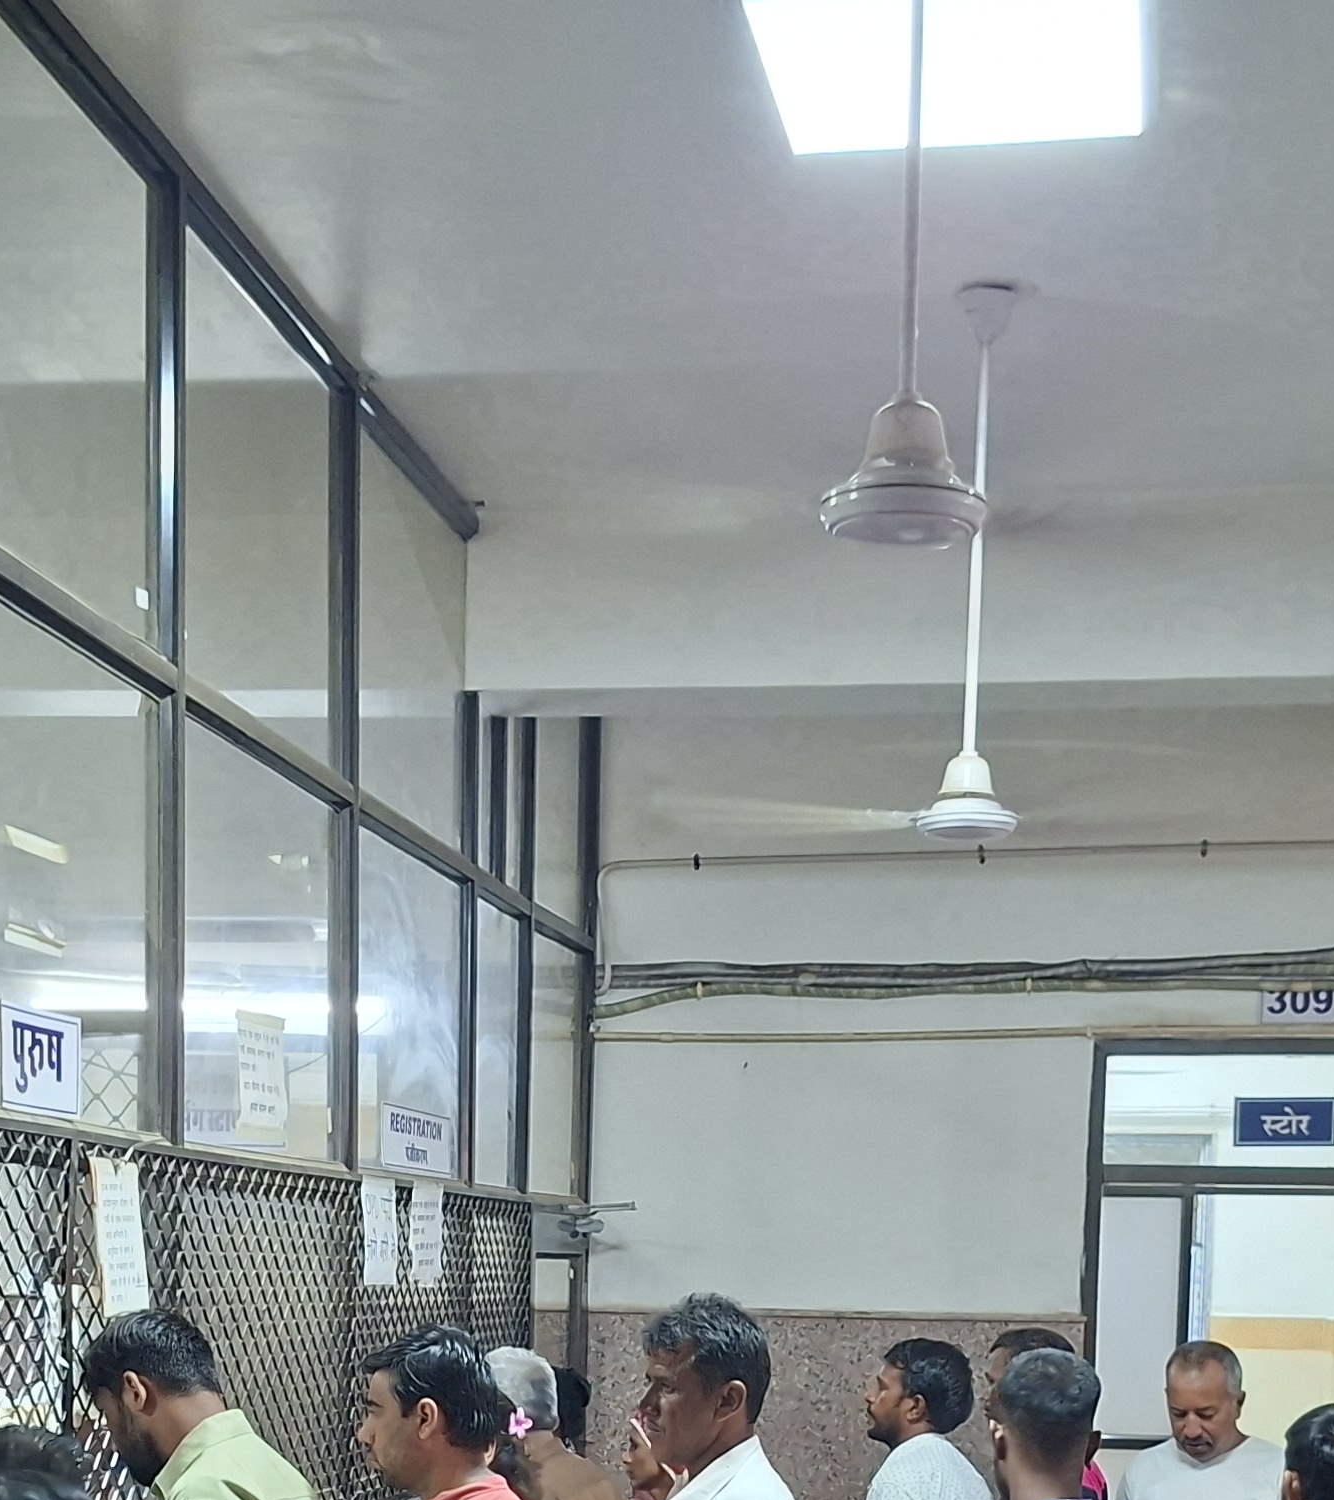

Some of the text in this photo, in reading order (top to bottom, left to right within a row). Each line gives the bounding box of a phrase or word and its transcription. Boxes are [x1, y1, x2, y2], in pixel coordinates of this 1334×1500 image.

[1267, 990, 1333, 1014] 309
[12, 1020, 64, 1093] पुरुष
[390, 1112, 442, 1141] REGISTRATION
[1260, 1106, 1311, 1136] स्टोर
